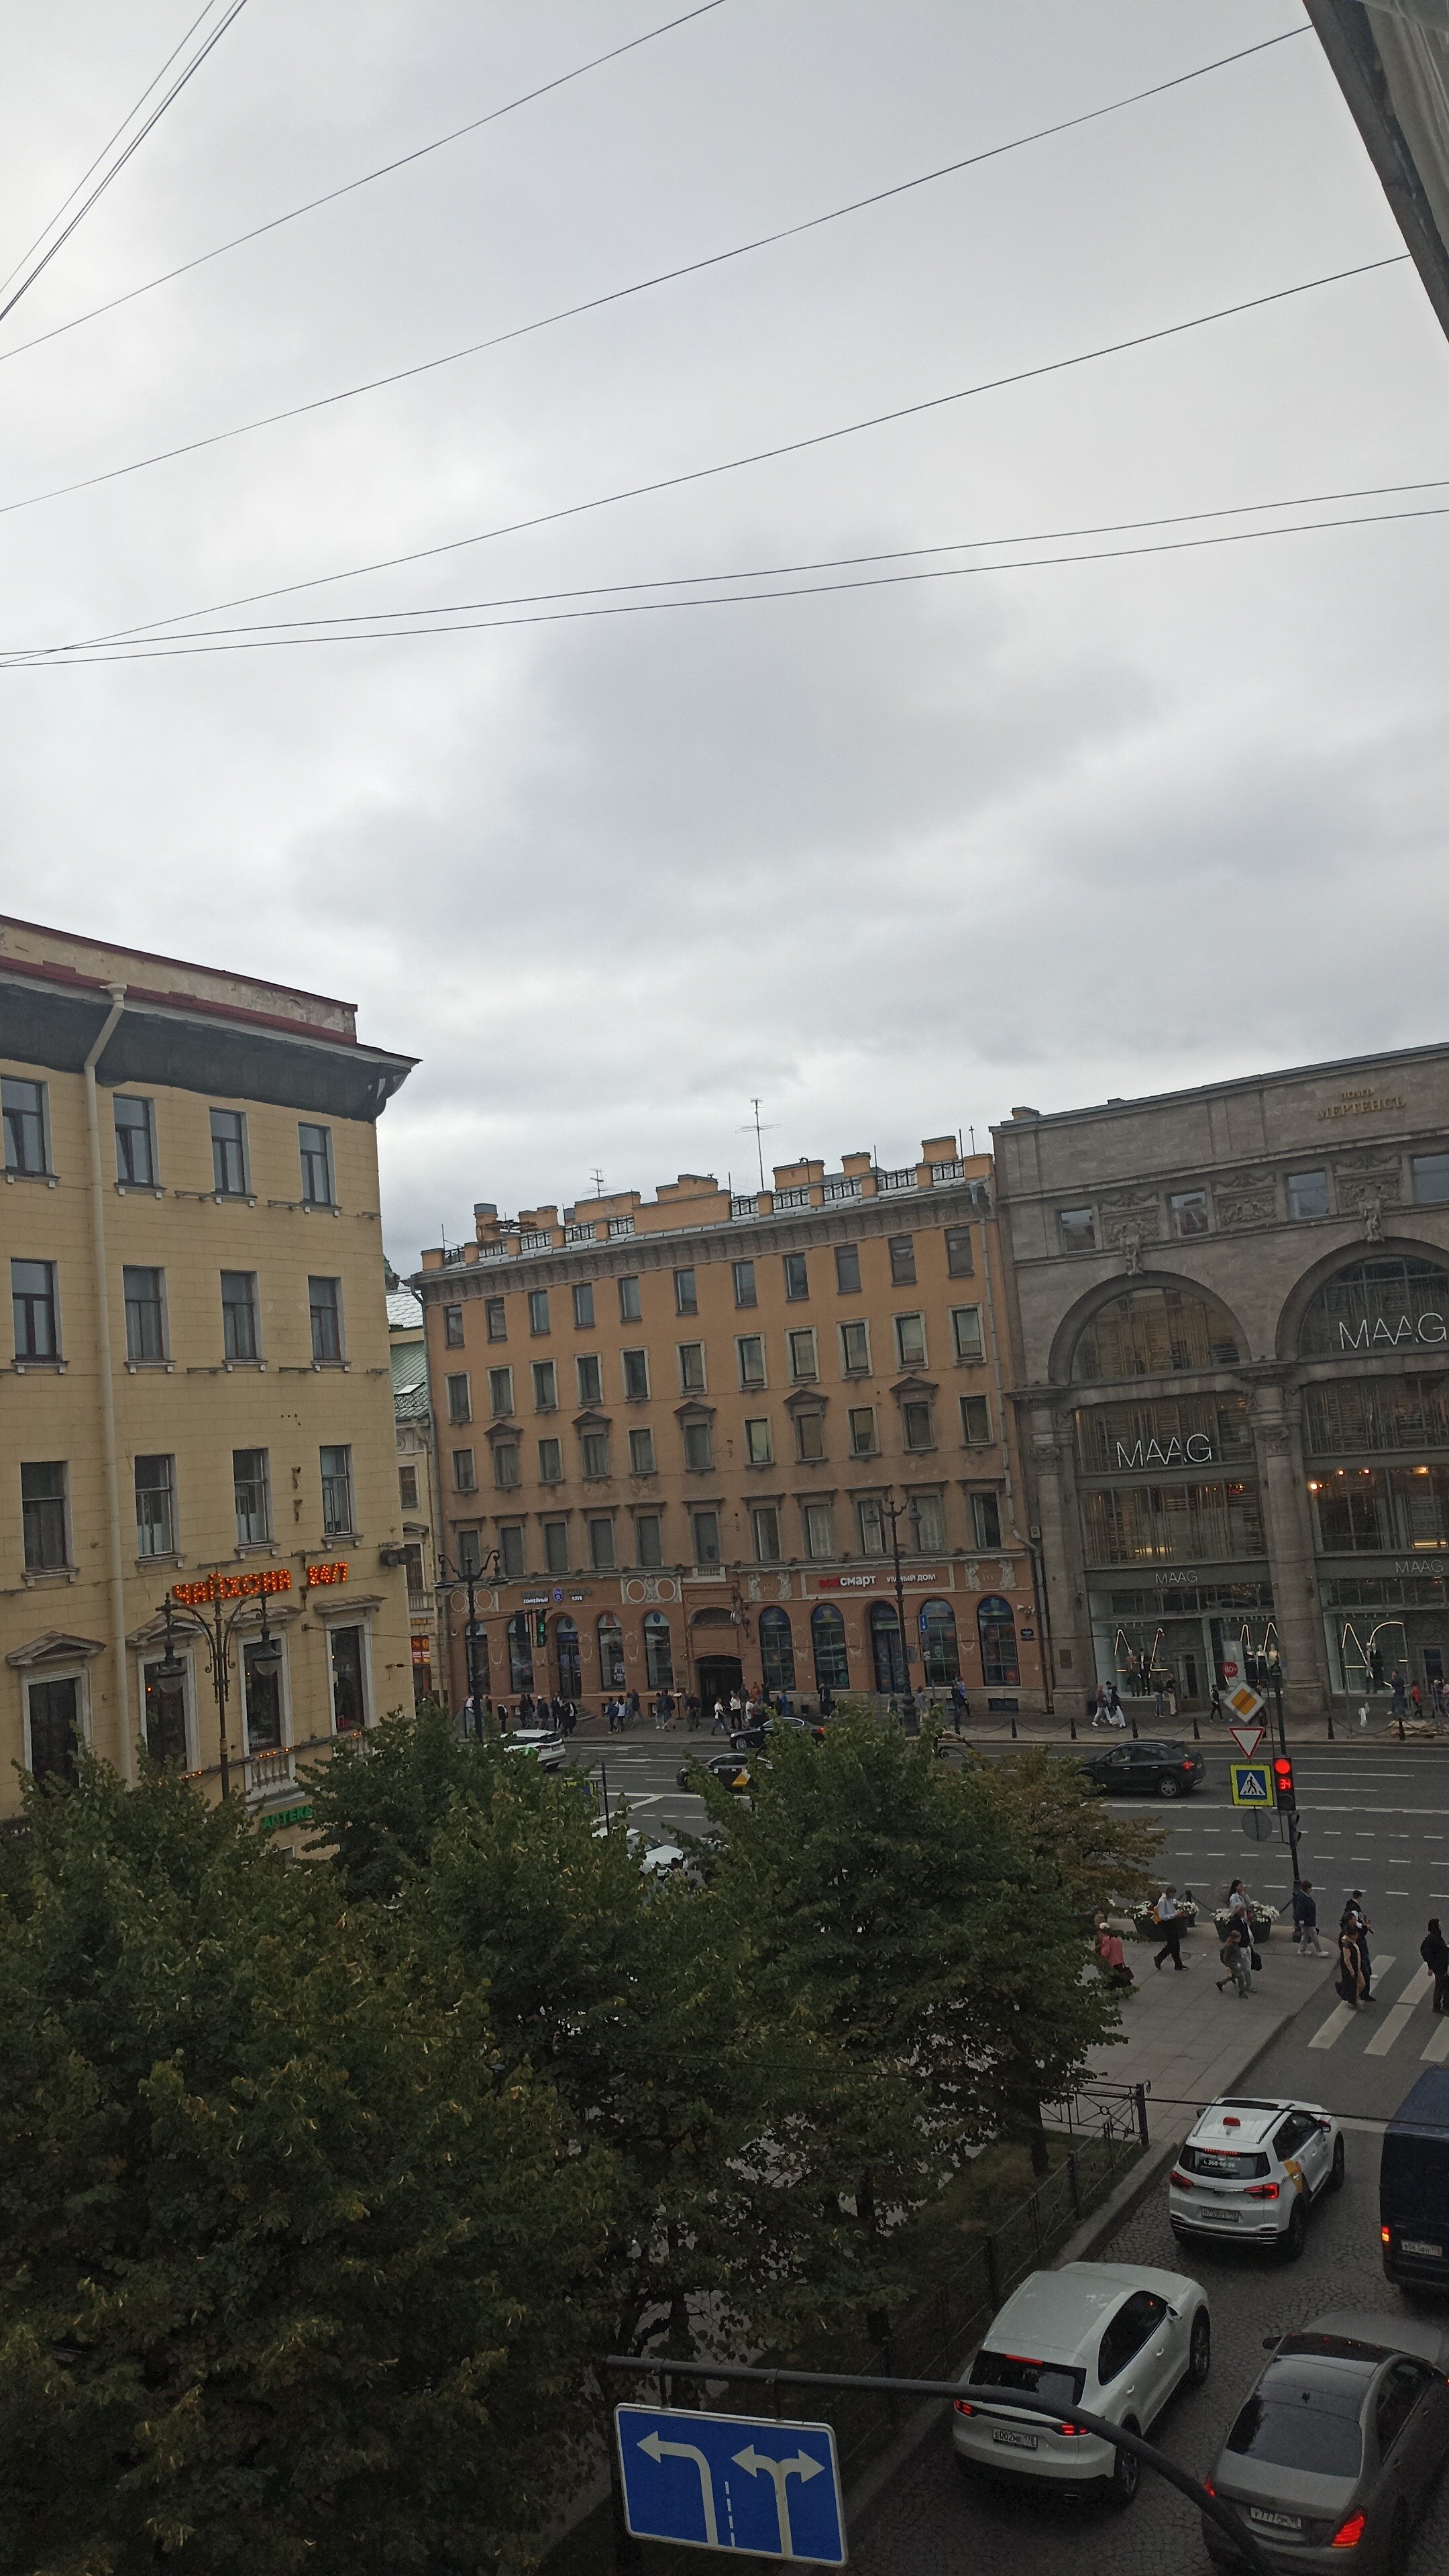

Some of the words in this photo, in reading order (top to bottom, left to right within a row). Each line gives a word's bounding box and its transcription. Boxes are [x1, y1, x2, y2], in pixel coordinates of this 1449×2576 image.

[1315, 1096, 1406, 1120] МЕРТЕНСЪ
[1339, 1312, 1447, 1350] MAAG
[1116, 1434, 1212, 1468] MAAG
[1395, 1559, 1444, 1574] MAAG
[172, 1568, 292, 1605] ЧАЙХОНА
[307, 1562, 349, 1587] 24/7
[917, 1574, 936, 1582] ДОМ
[1155, 1570, 1198, 1585] MAAG
[1279, 1778, 1291, 1789] 34
